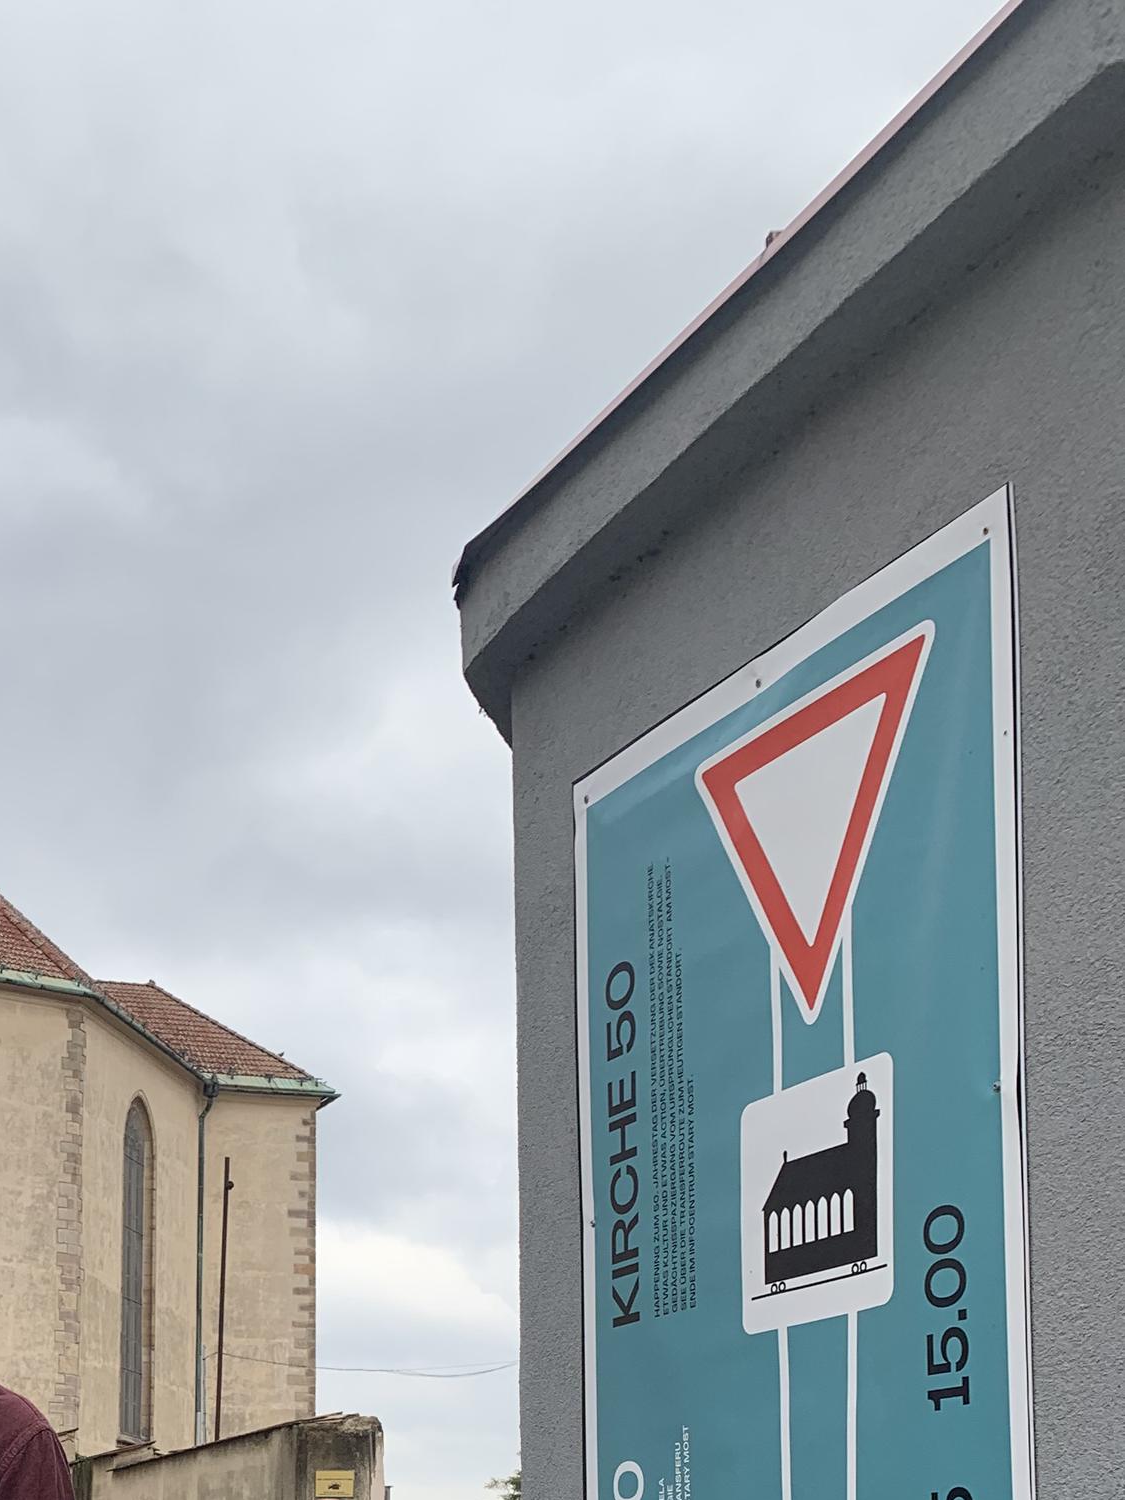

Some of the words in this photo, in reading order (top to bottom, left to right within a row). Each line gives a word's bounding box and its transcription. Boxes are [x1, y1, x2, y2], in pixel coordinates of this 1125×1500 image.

[666, 903, 672, 922] AM
[605, 960, 637, 1063] 50
[666, 995, 675, 1110] URSPRÜNGLICHEN
[606, 1070, 641, 1329] KIRCHE
[689, 1258, 695, 1273] IM
[924, 1204, 971, 1412] 15.00
